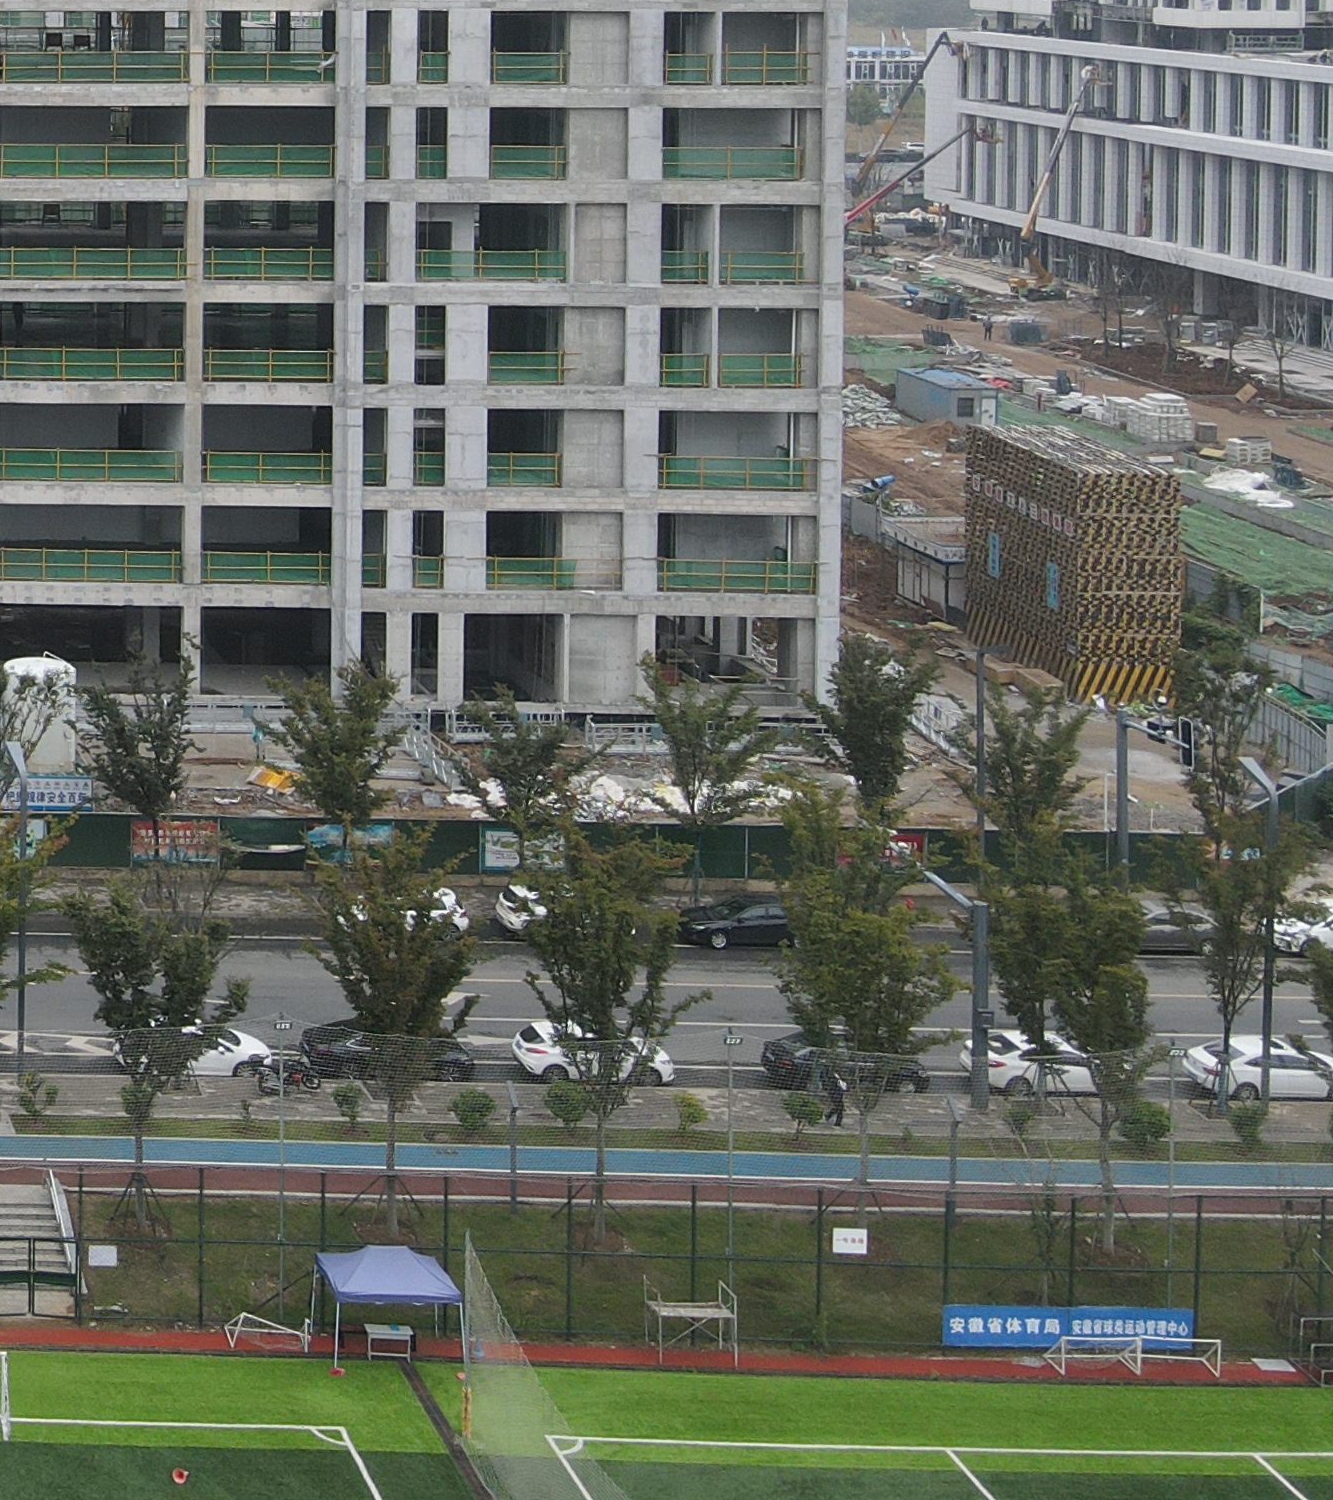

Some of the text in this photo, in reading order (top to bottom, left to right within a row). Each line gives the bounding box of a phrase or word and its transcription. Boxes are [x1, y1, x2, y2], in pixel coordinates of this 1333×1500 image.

[949, 1316, 1060, 1335] 安徽省体育局
